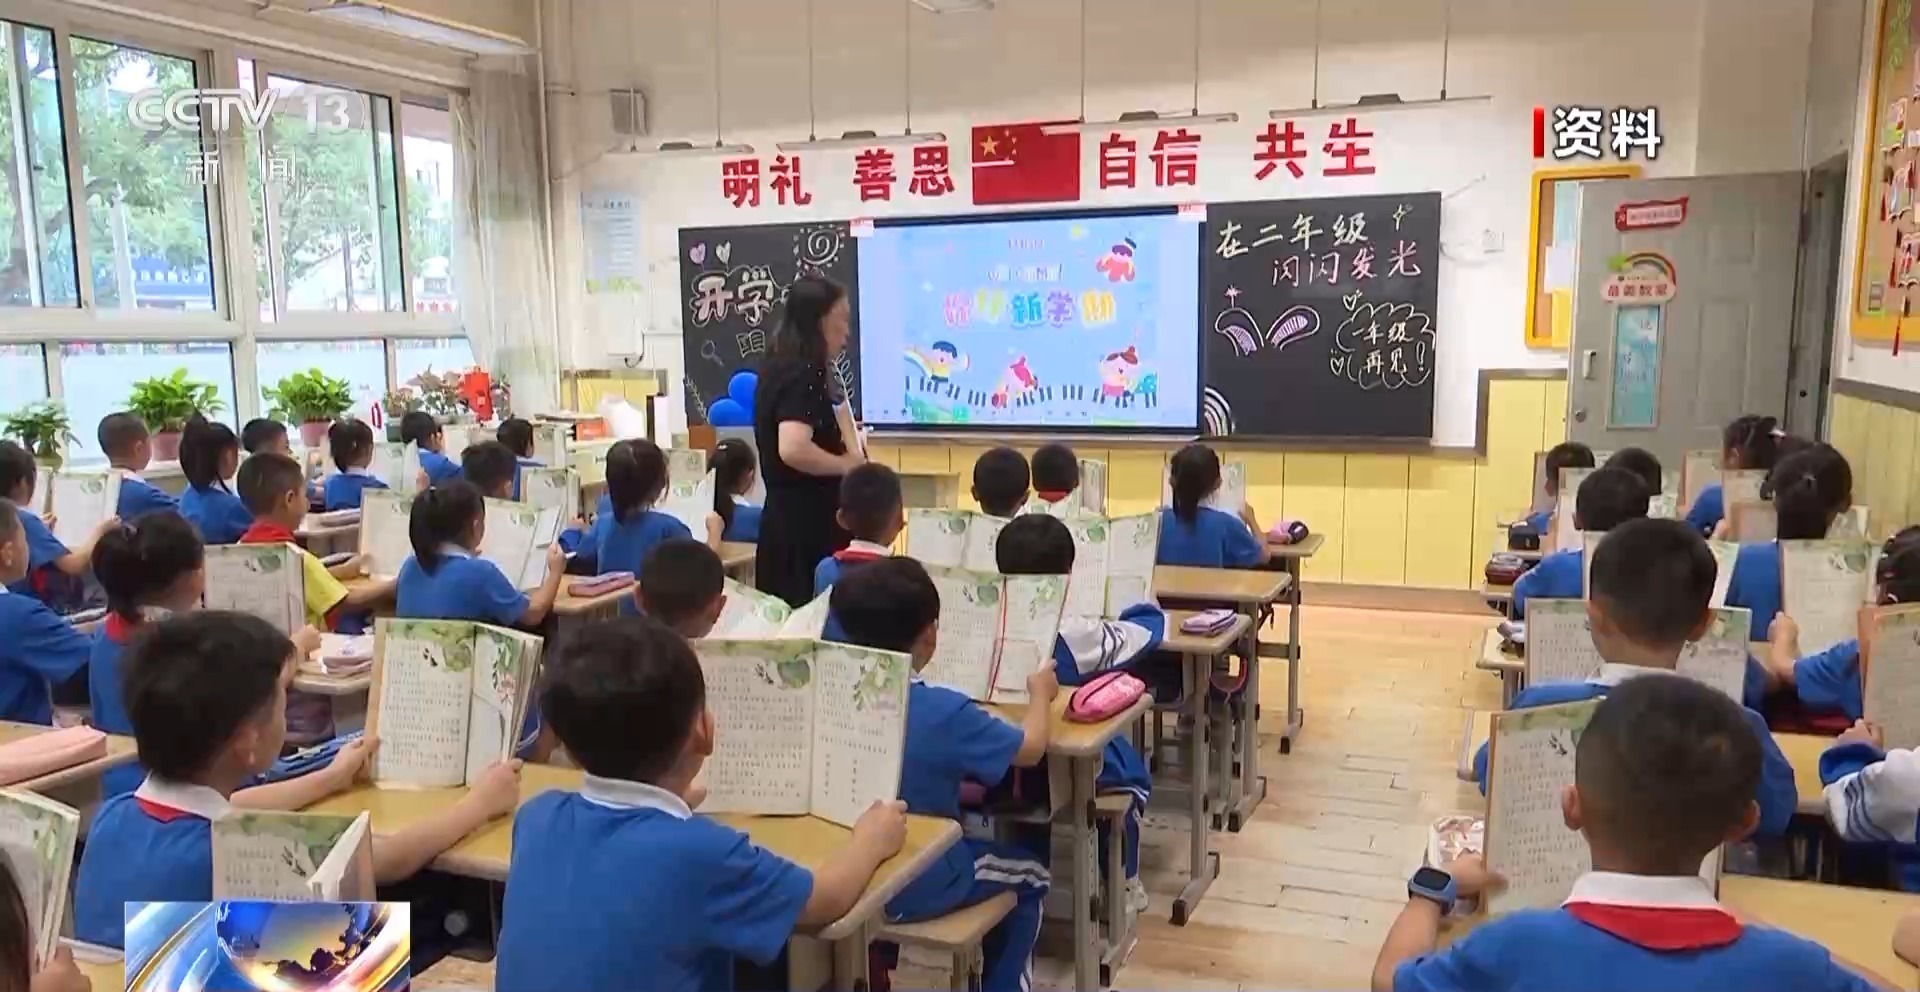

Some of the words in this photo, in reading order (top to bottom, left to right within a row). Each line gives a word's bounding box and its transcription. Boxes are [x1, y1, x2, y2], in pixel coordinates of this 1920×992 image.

[721, 155, 812, 207] 明礼
[852, 146, 955, 202] 善思
[1099, 128, 1201, 190] 自信
[1253, 118, 1376, 181] 共生
[1216, 212, 1370, 259] 在二年级
[1272, 240, 1422, 287] 闪闪发光
[695, 271, 791, 322] 开学
[1352, 320, 1413, 345] 一年级
